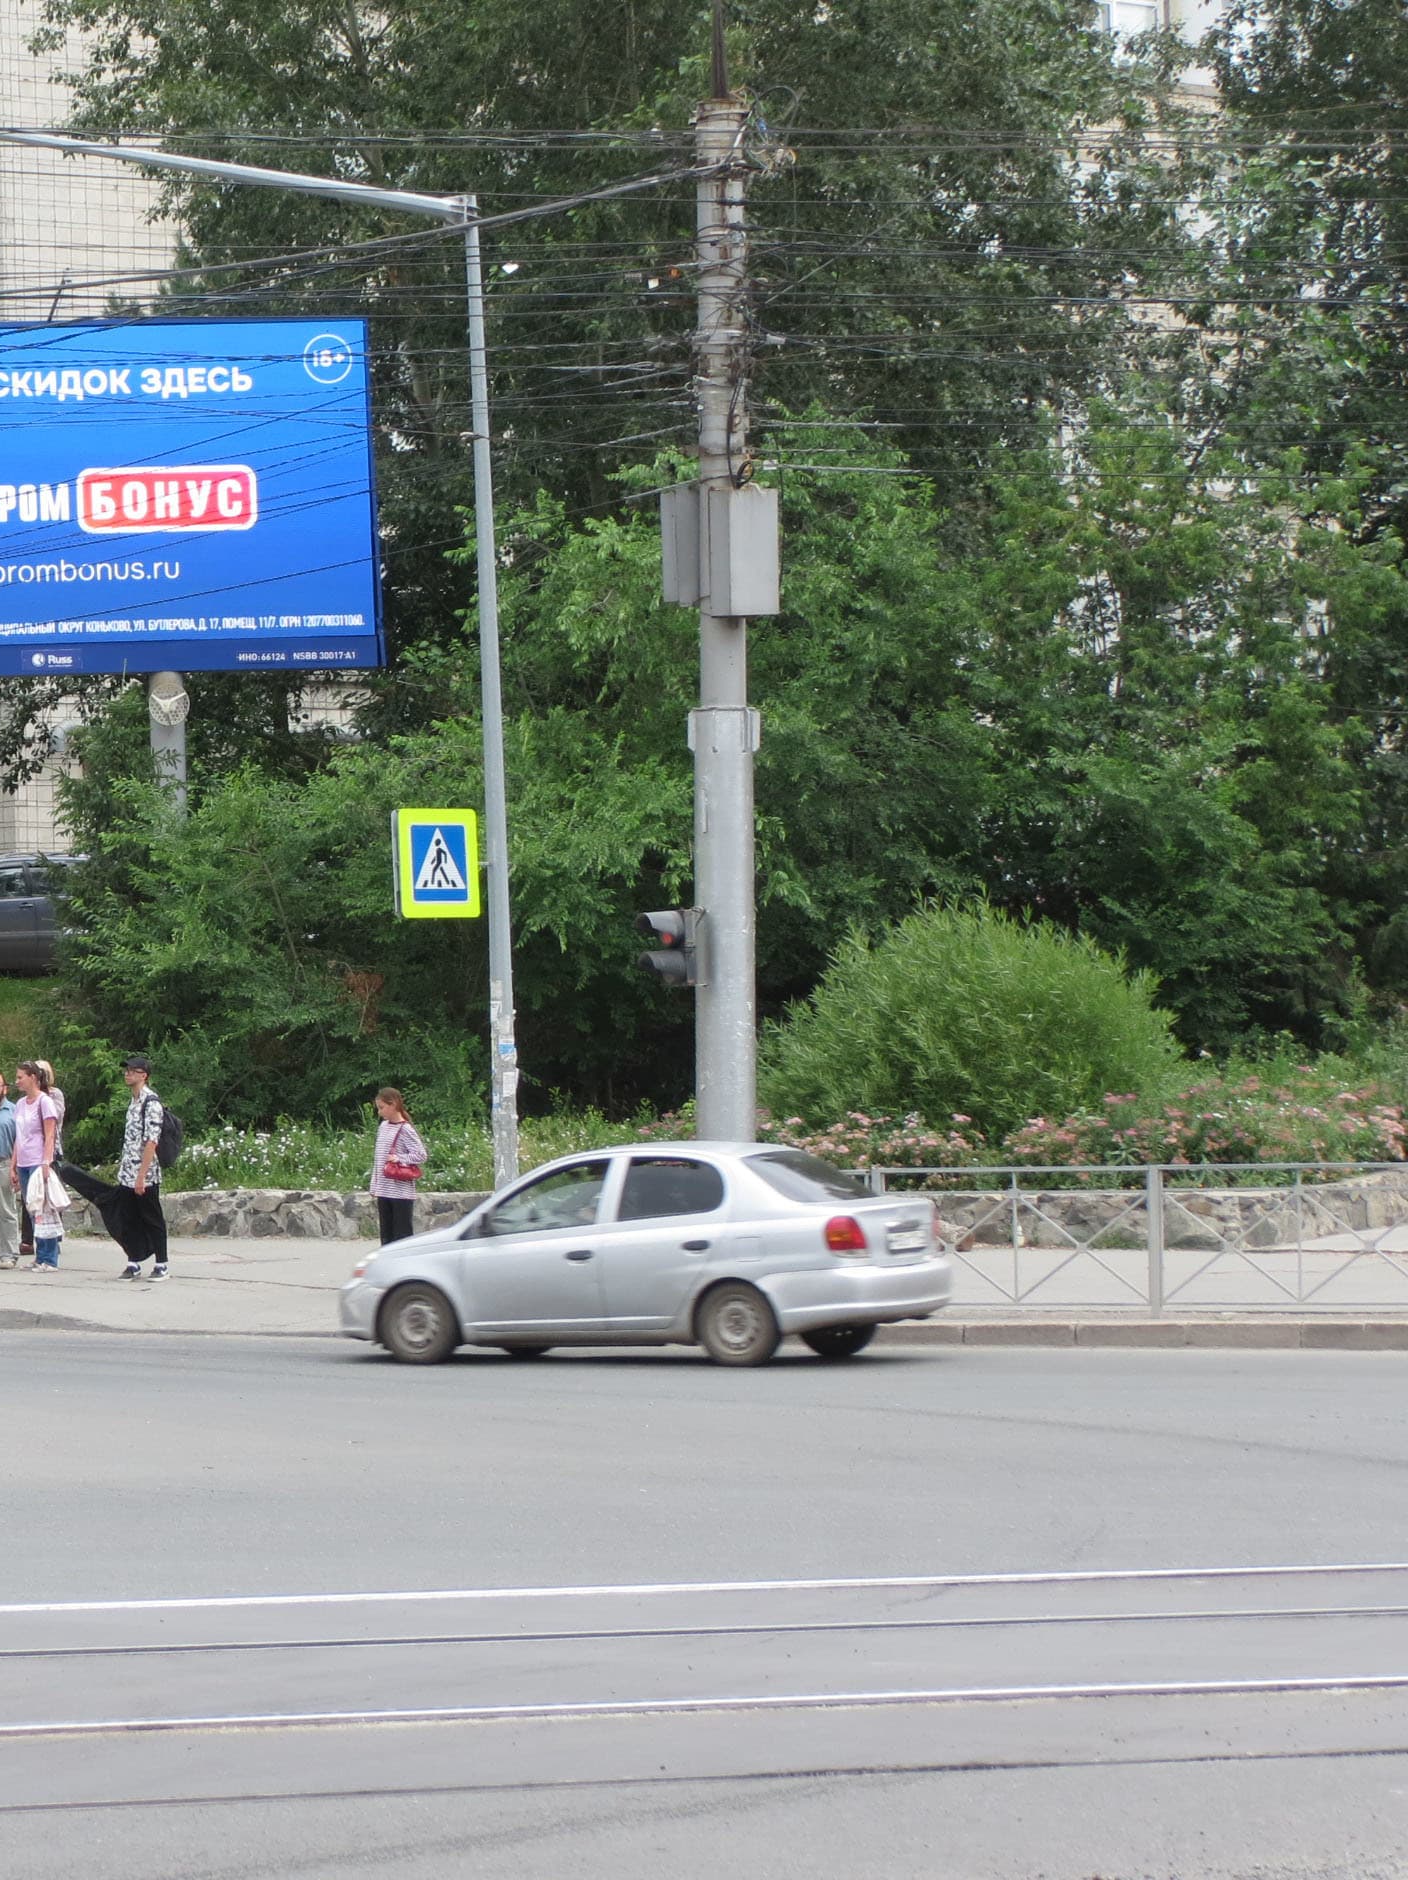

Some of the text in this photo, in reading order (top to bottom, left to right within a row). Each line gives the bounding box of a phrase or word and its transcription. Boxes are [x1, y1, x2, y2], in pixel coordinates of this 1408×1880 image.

[140, 366, 253, 399] ЗДЕСЬ
[92, 479, 243, 521] БОНУС
[58, 620, 84, 634] ОКРУГ
[85, 618, 132, 633] КОНЬКОВО,
[133, 619, 147, 632] УЛ.
[279, 615, 301, 628] ОГРН
[47, 654, 73, 665] Russ
